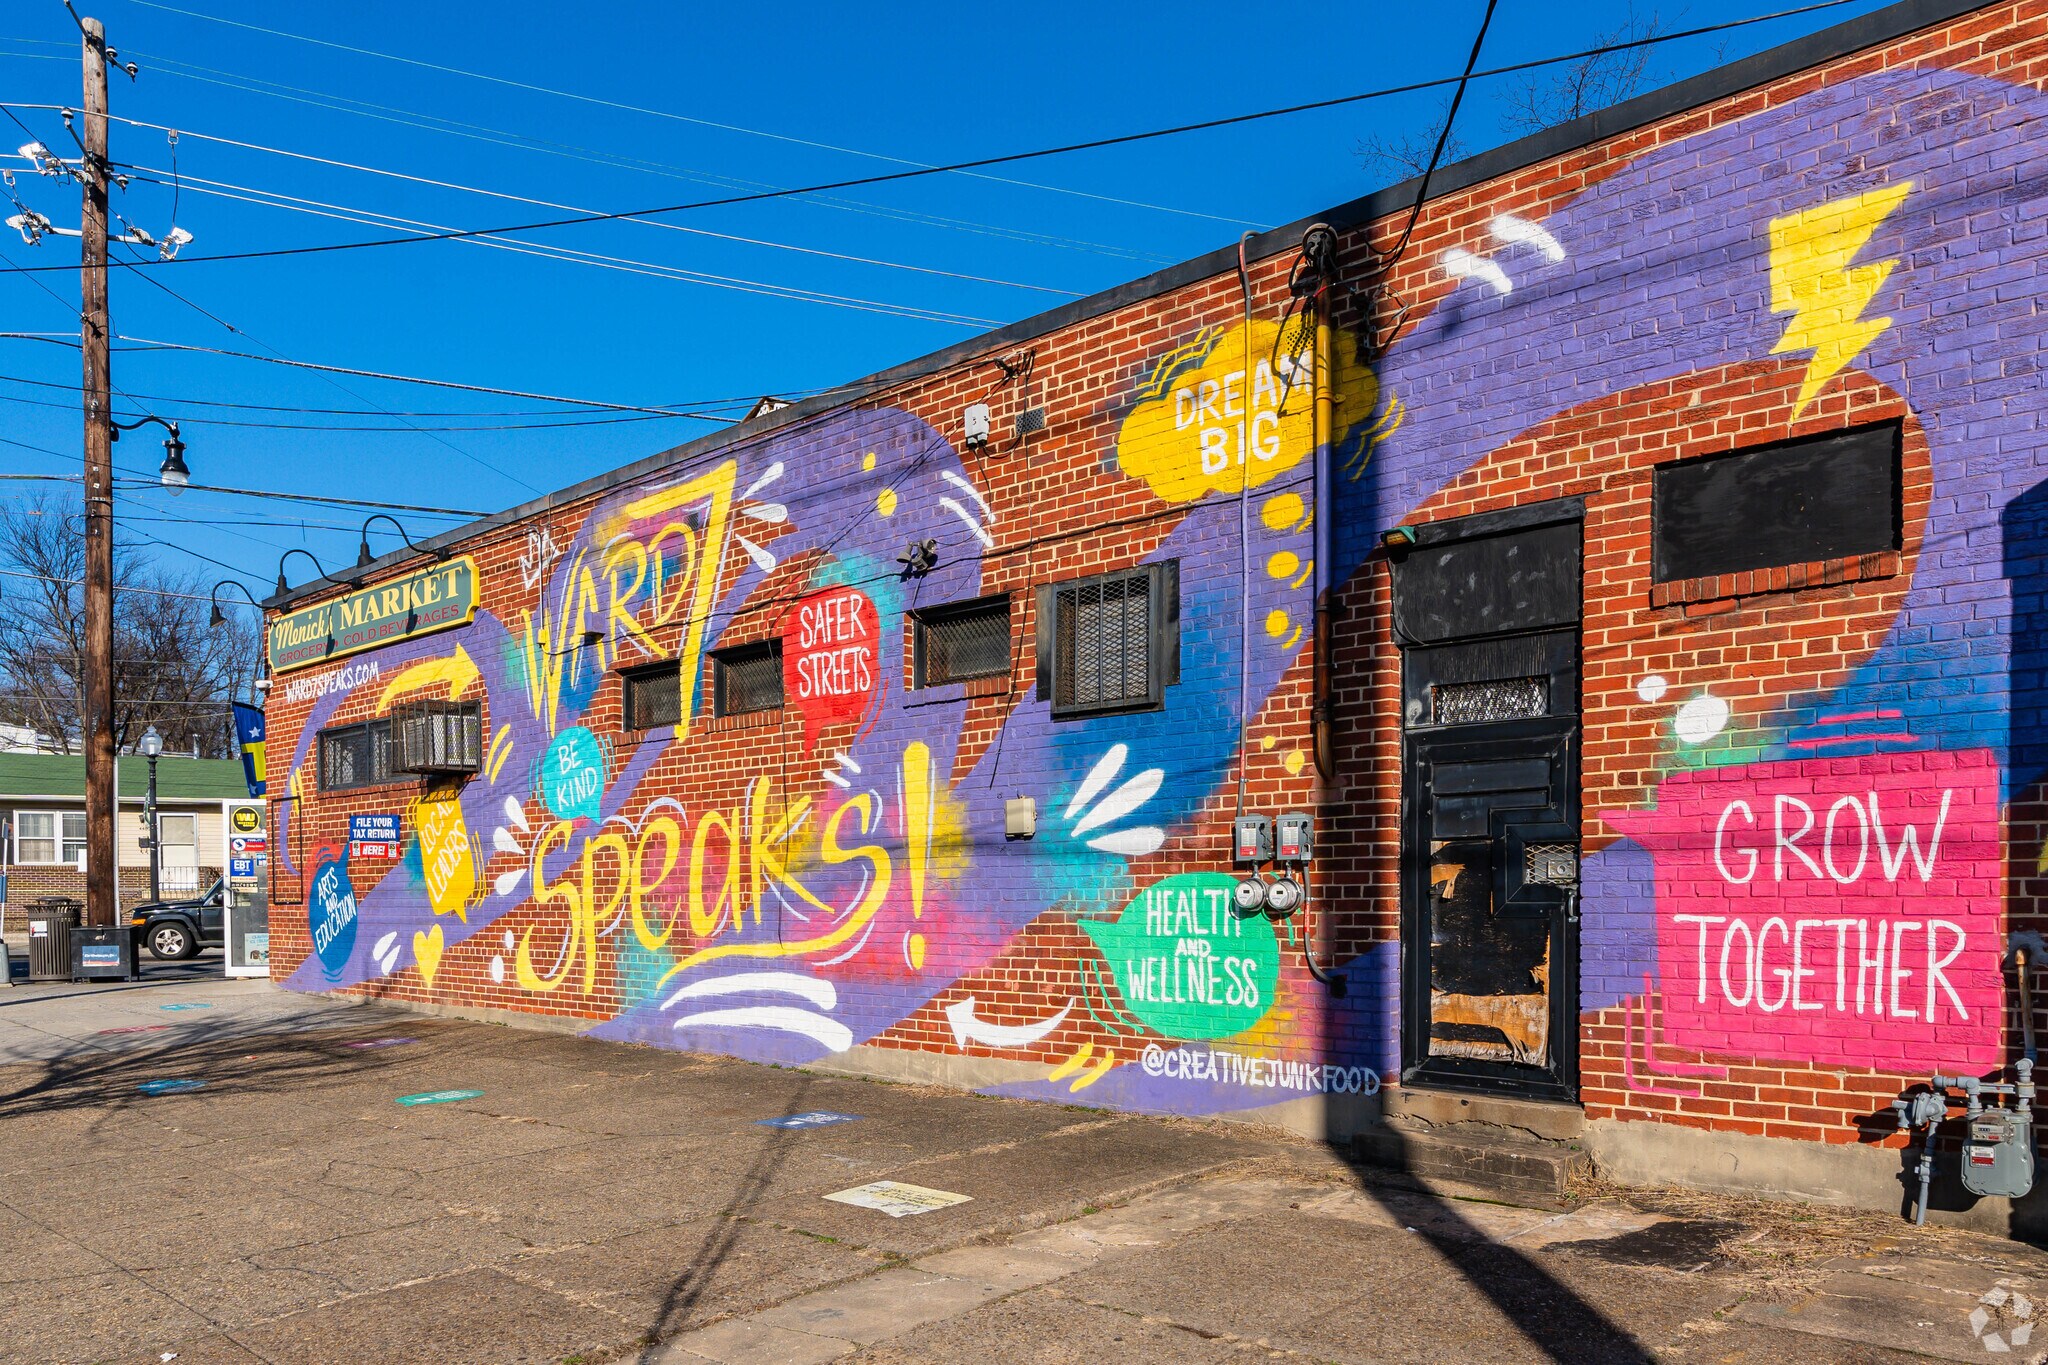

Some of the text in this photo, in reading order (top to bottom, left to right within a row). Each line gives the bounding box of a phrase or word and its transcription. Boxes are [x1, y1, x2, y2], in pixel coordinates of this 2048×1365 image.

[1175, 349, 1314, 432] DREAM
[1199, 410, 1279, 475] BIG
[275, 566, 463, 650] Menick's MARKET
[521, 459, 738, 742] WARD 7
[799, 594, 866, 649] SAFER
[278, 642, 329, 665] GROCERY
[343, 628, 377, 646] COLD
[286, 661, 380, 704] WARD7SPEAKS.COM
[797, 647, 871, 698] STREETS
[558, 739, 582, 775] BE
[557, 767, 597, 812] KIND
[352, 829, 396, 839] TAX RETURN
[356, 817, 392, 827] FILE YOUR
[421, 801, 454, 855] LOCAL
[1714, 789, 1952, 884] GROW
[233, 860, 250, 870] EBT
[362, 845, 386, 856] HERE!
[428, 819, 469, 904] LEADERS
[318, 867, 338, 906] ARTS
[326, 892, 338, 916] AND
[315, 891, 356, 954] EDUCATION
[1145, 887, 1241, 938] HEALTH
[1174, 938, 1211, 957] AND
[1673, 914, 1969, 1023] TOGETHER
[1126, 956, 1259, 1008] WELLNESS
[1141, 1043, 1381, 1096] @CREATIVEJUNKFOOD
